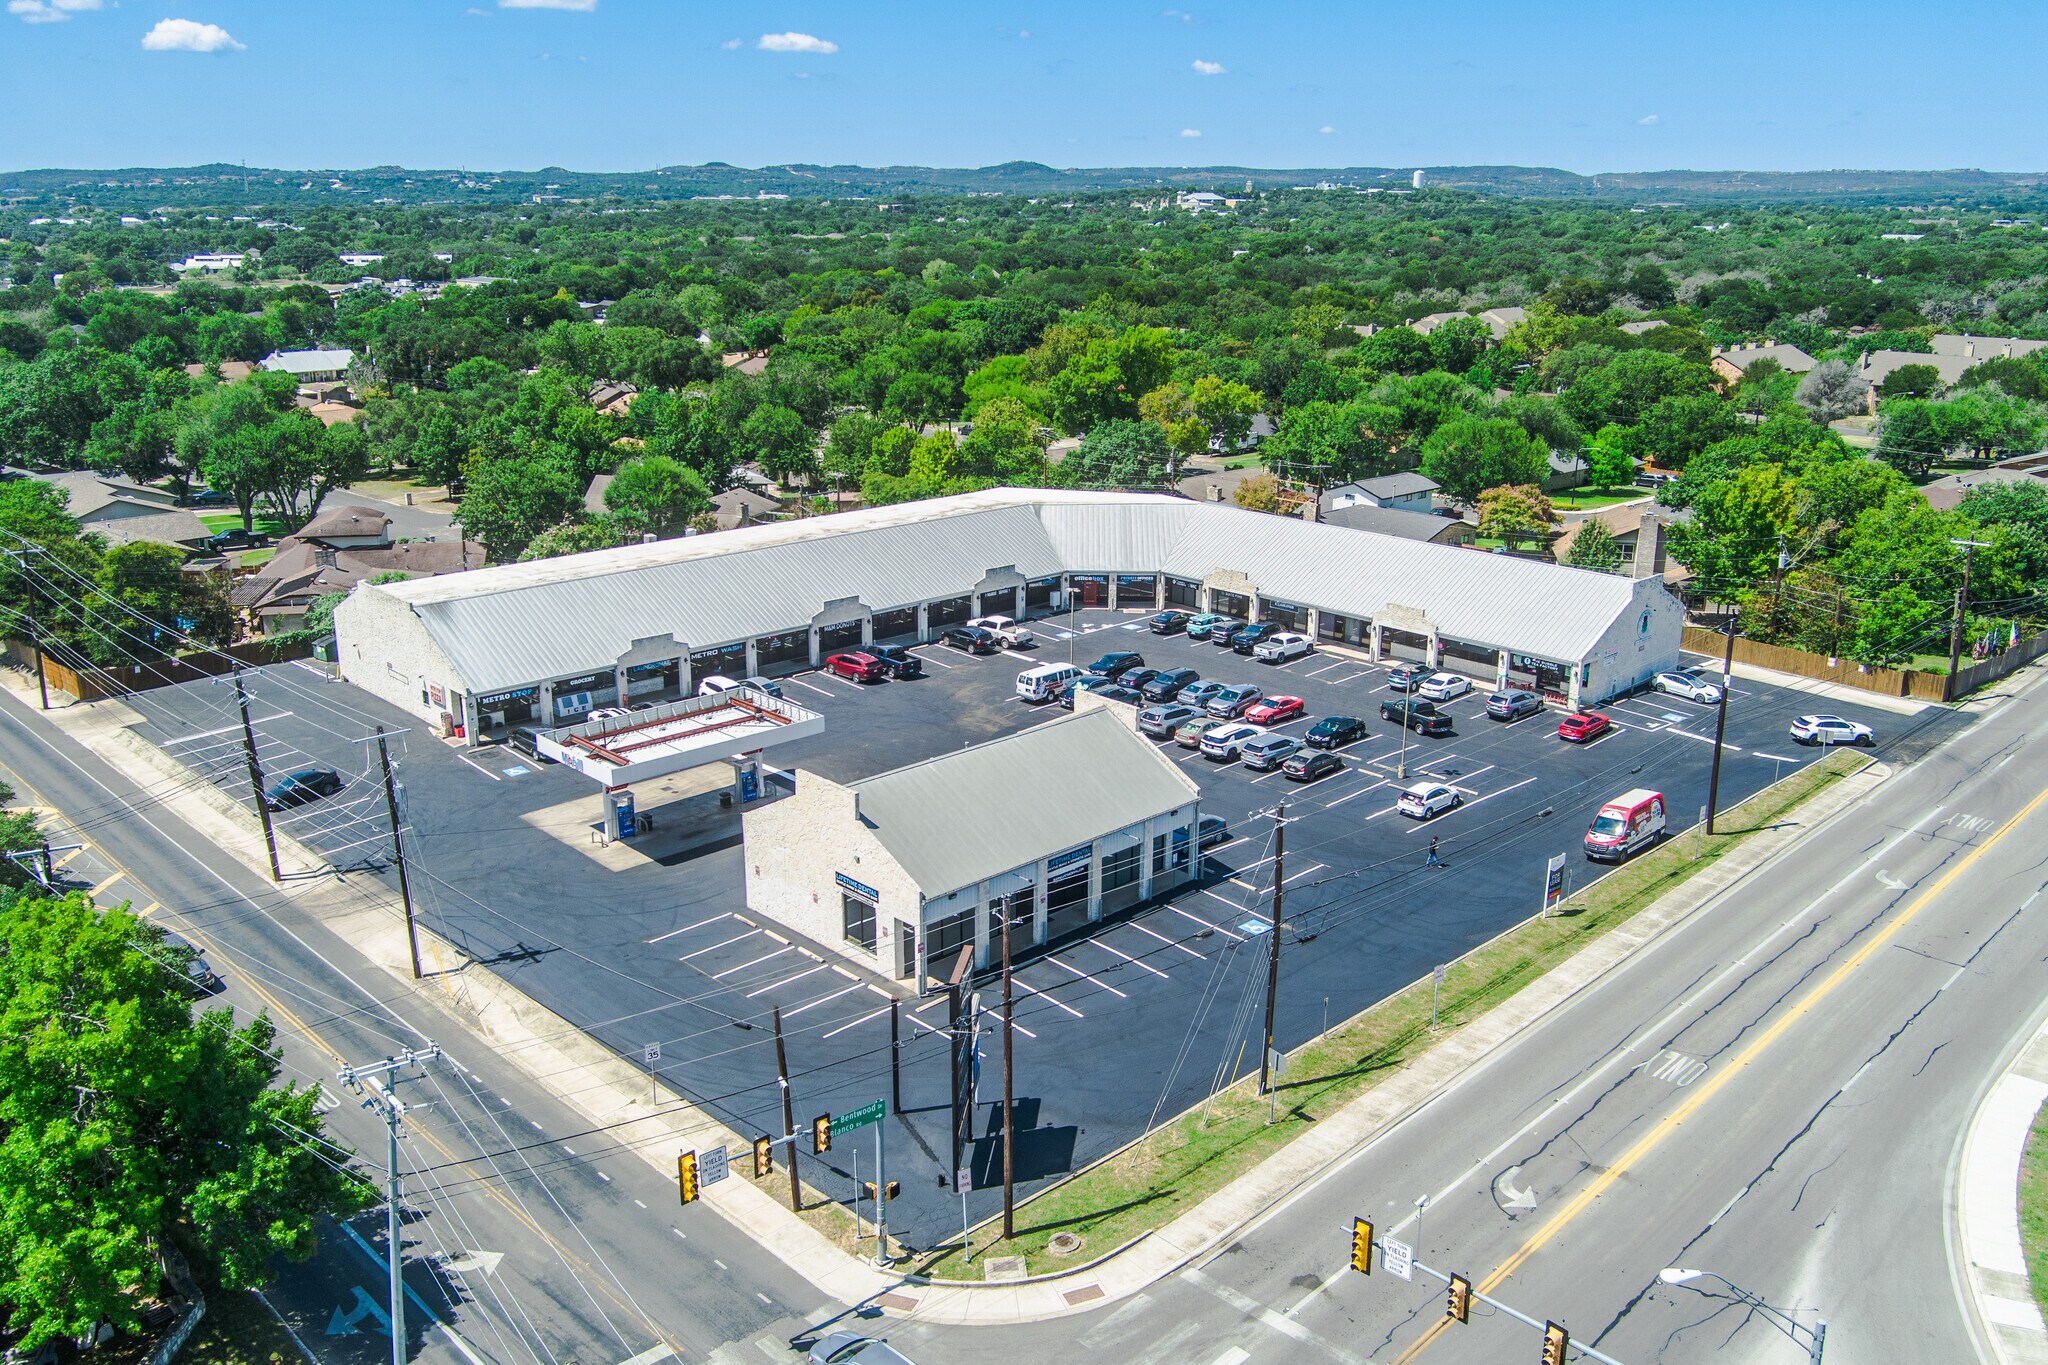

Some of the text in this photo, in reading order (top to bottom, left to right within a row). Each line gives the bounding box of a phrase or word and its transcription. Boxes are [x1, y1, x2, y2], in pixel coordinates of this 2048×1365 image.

[691, 644, 742, 660] METRO WASH
[570, 676, 595, 686] GROCERY
[482, 688, 533, 704] METRO STOP
[568, 705, 586, 714] ICE
[1940, 812, 1995, 832] ONLY
[1071, 847, 1091, 859] DENTAL
[836, 873, 858, 888] LIFETIME
[858, 882, 877, 898] DENTAL
[648, 1050, 659, 1060] 35
[1632, 1048, 1708, 1086] ONLY
[840, 1103, 876, 1124] Bentwood
[830, 1124, 854, 1138] Blanco
[705, 1156, 722, 1166] YIELD
[708, 1161, 725, 1171] FLASHING
[1388, 1245, 1407, 1258] YIELD
